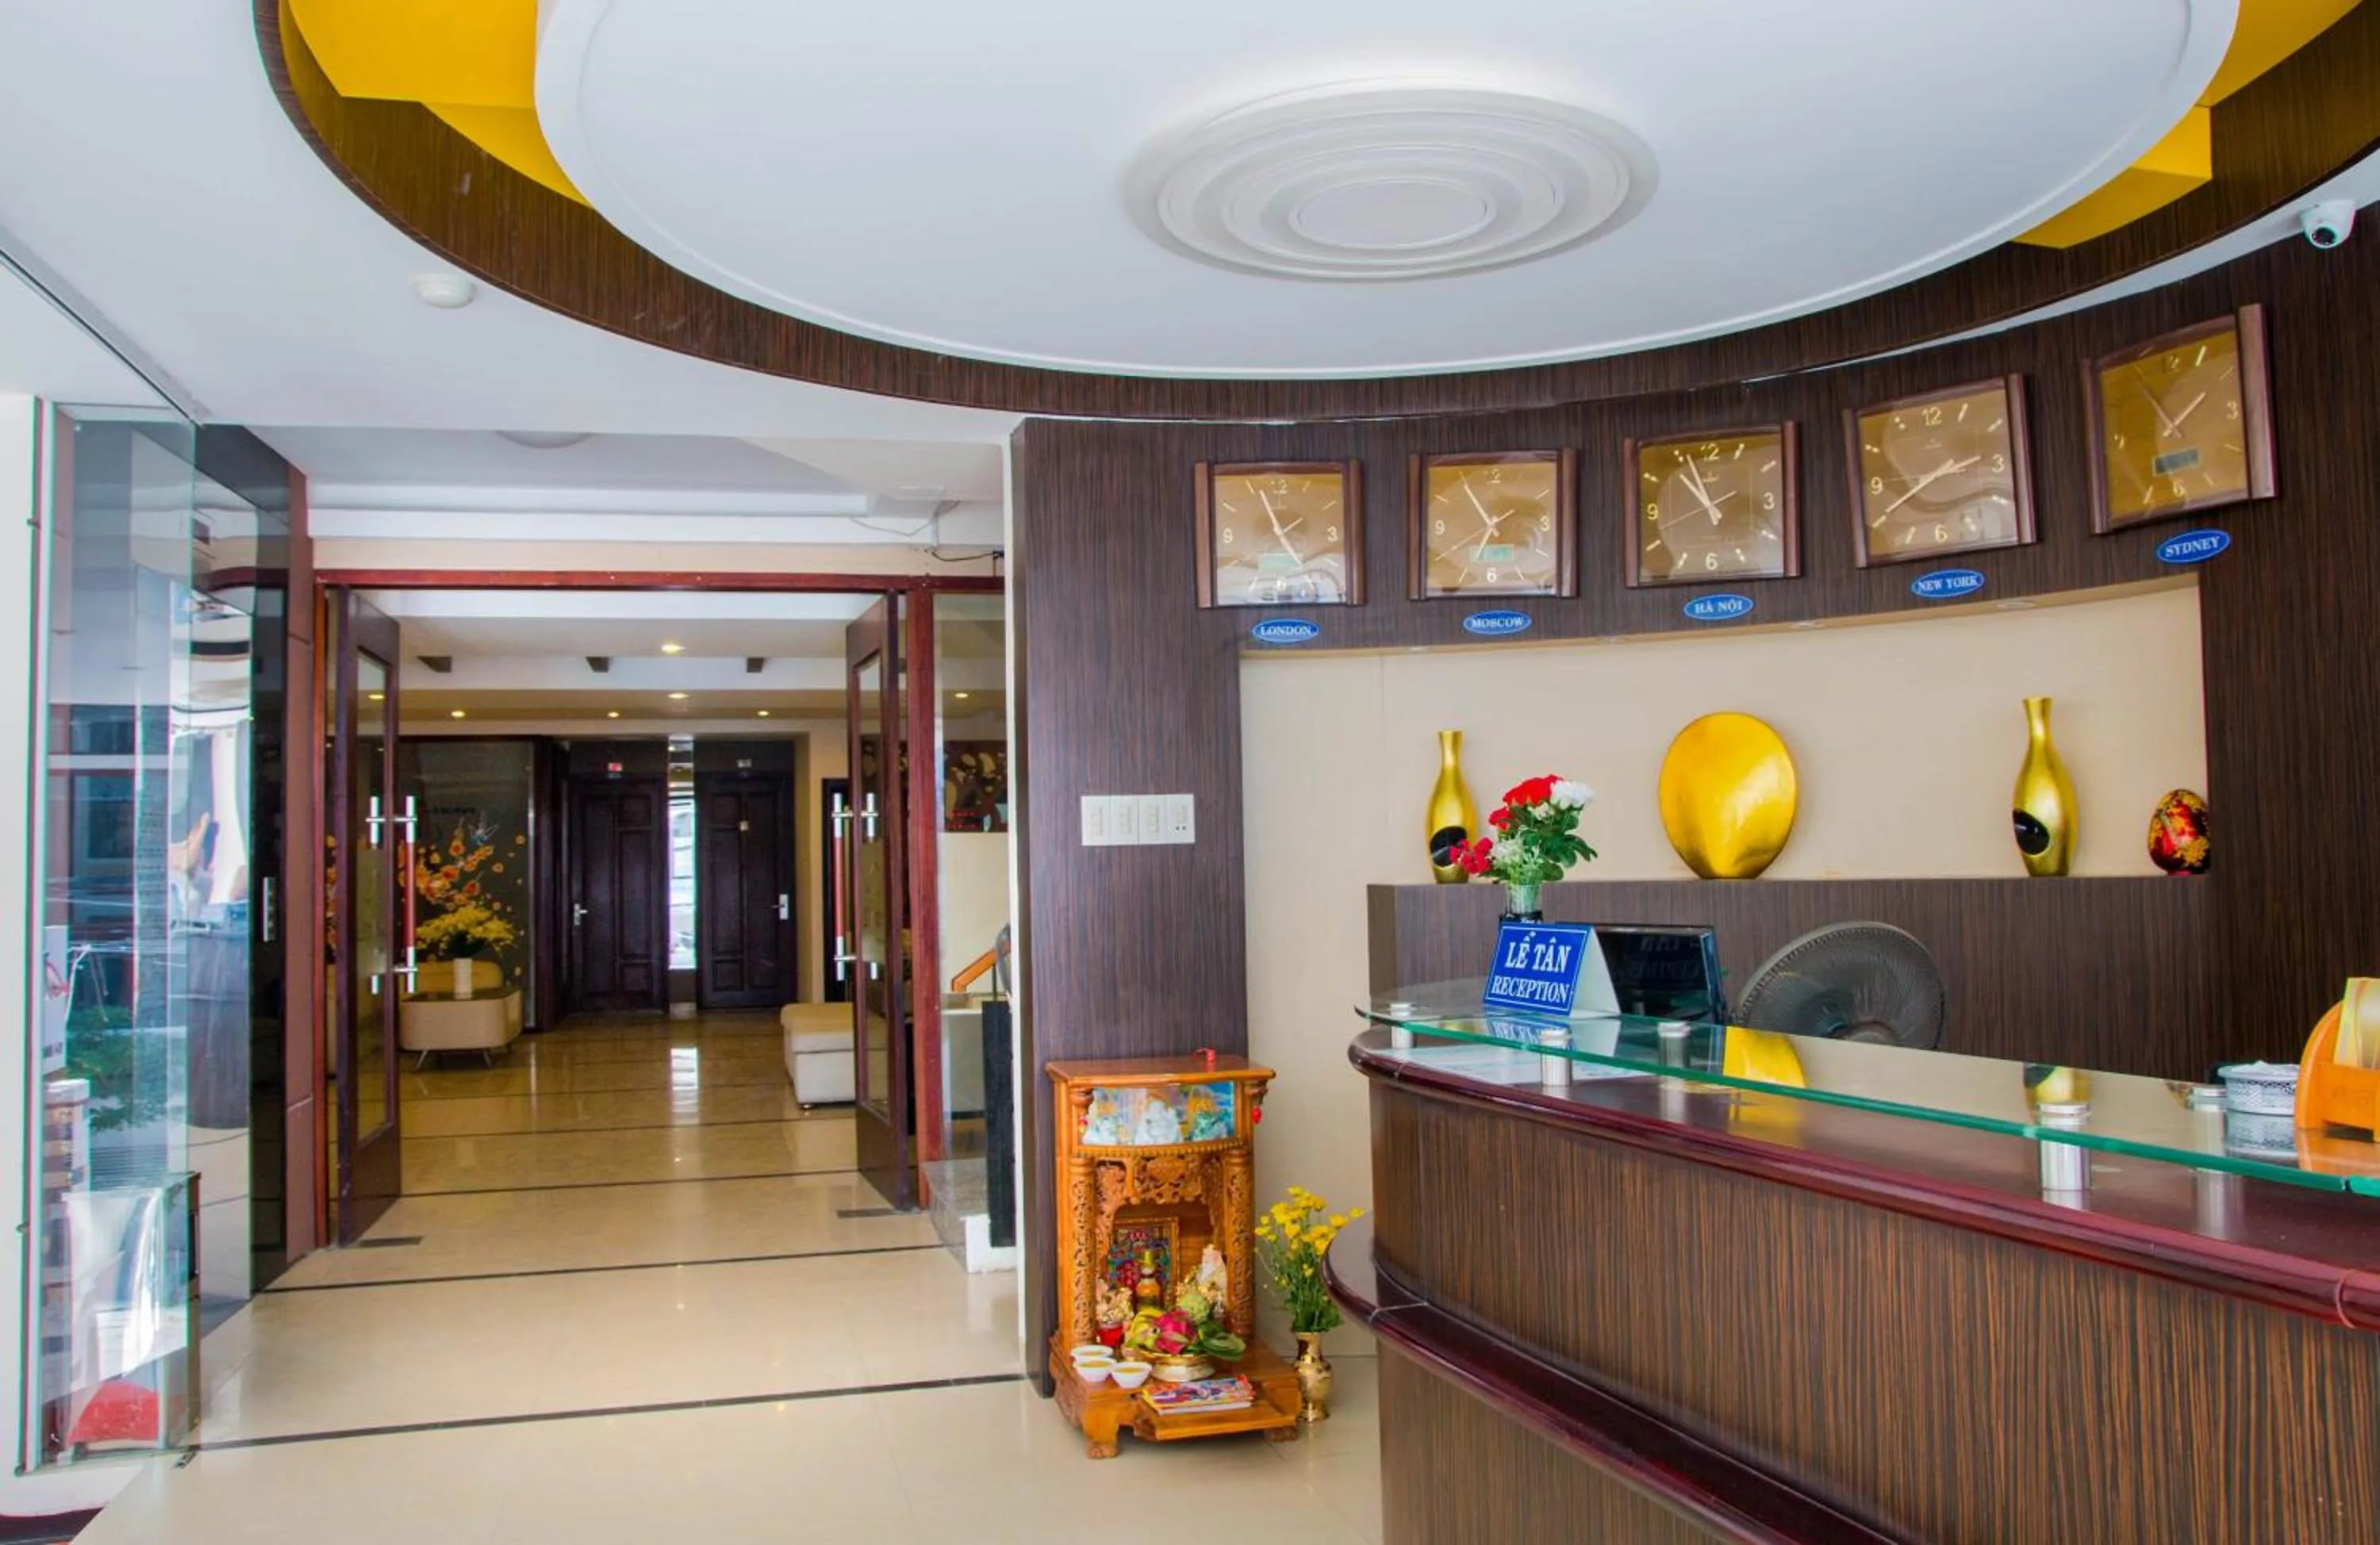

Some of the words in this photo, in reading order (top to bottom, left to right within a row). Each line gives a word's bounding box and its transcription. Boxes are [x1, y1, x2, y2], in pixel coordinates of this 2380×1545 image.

[1922, 407, 1942, 426] 12
[1991, 454, 2005, 473] 3
[1870, 476, 1883, 495] 9
[1763, 492, 1775, 510] 3
[1646, 503, 1659, 520] 9
[1434, 519, 1445, 535] 9
[1539, 516, 1550, 532] 3
[1934, 523, 1948, 542] 6
[1326, 525, 1338, 542] 3
[2164, 536, 2221, 558] SYDNEY
[1705, 552, 1718, 571] 6
[1486, 566, 1497, 583] 6
[1918, 579, 1943, 592] NEW
[1945, 575, 1979, 589] YORK
[1718, 597, 1743, 613] NỘI
[1260, 625, 1311, 636] LONDON
[1472, 616, 1524, 628] MOSCOW
[1531, 936, 1572, 973] TÂN
[1490, 975, 1571, 1004] RECEPTION
